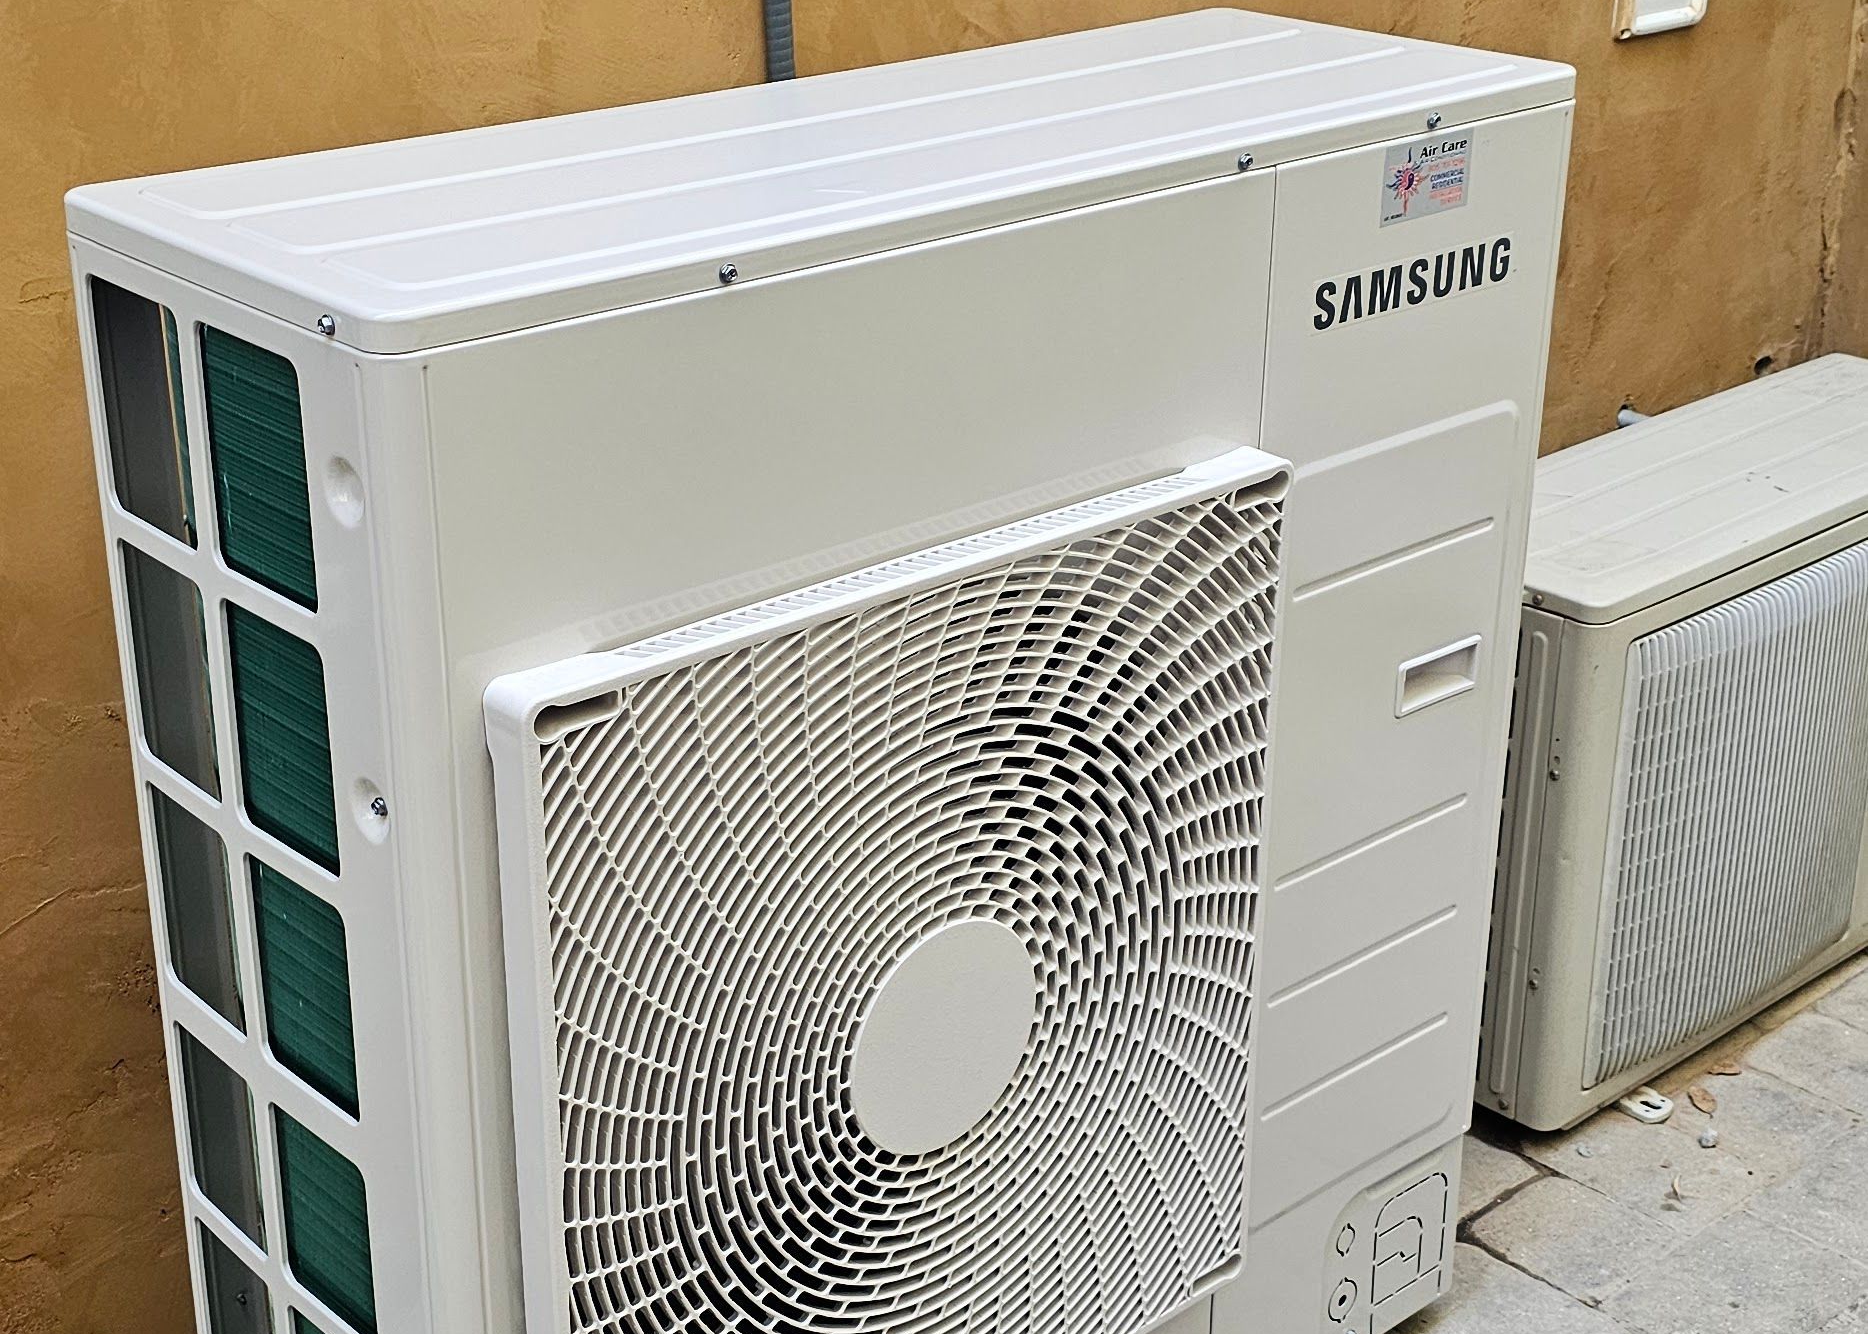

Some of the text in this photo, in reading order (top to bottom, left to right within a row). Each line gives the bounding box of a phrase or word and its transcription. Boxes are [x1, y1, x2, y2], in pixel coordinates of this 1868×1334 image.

[1420, 146, 1438, 158] Air
[1441, 139, 1467, 153] Care
[1313, 237, 1511, 330] SAMSUNG
